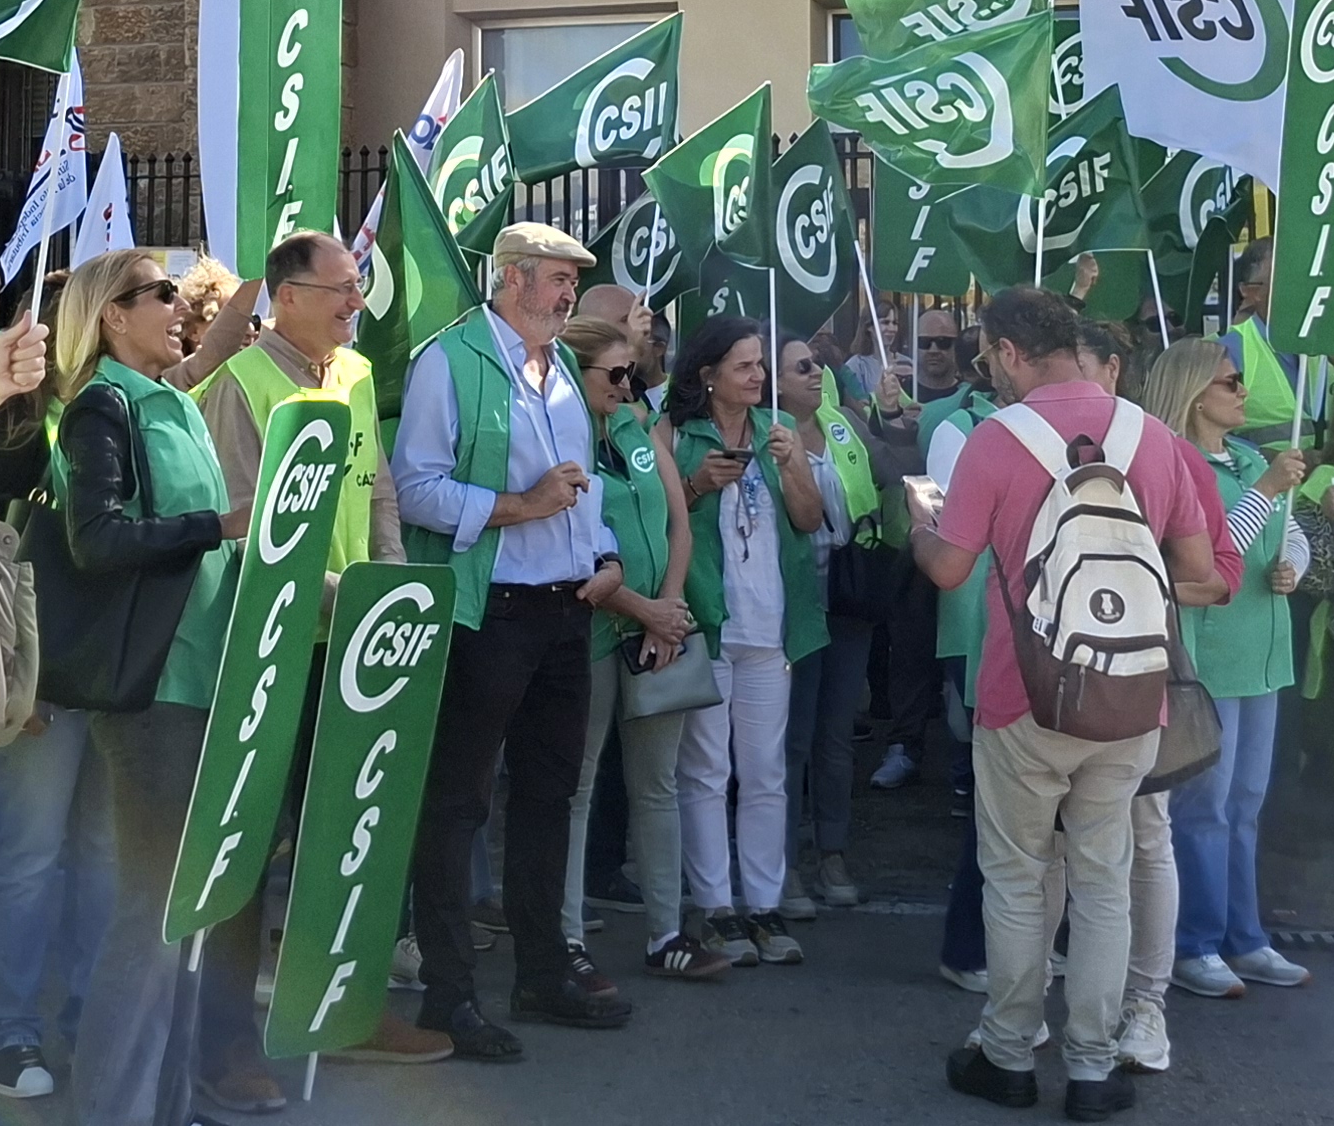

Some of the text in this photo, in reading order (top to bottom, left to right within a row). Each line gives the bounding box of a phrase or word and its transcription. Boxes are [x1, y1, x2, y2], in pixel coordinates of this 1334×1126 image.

[636, 449, 655, 466] CSIF
[276, 462, 337, 515] CSIF
[364, 624, 440, 668] CSIF
[195, 580, 295, 911] CSIF
[309, 729, 398, 1032] CSIF
